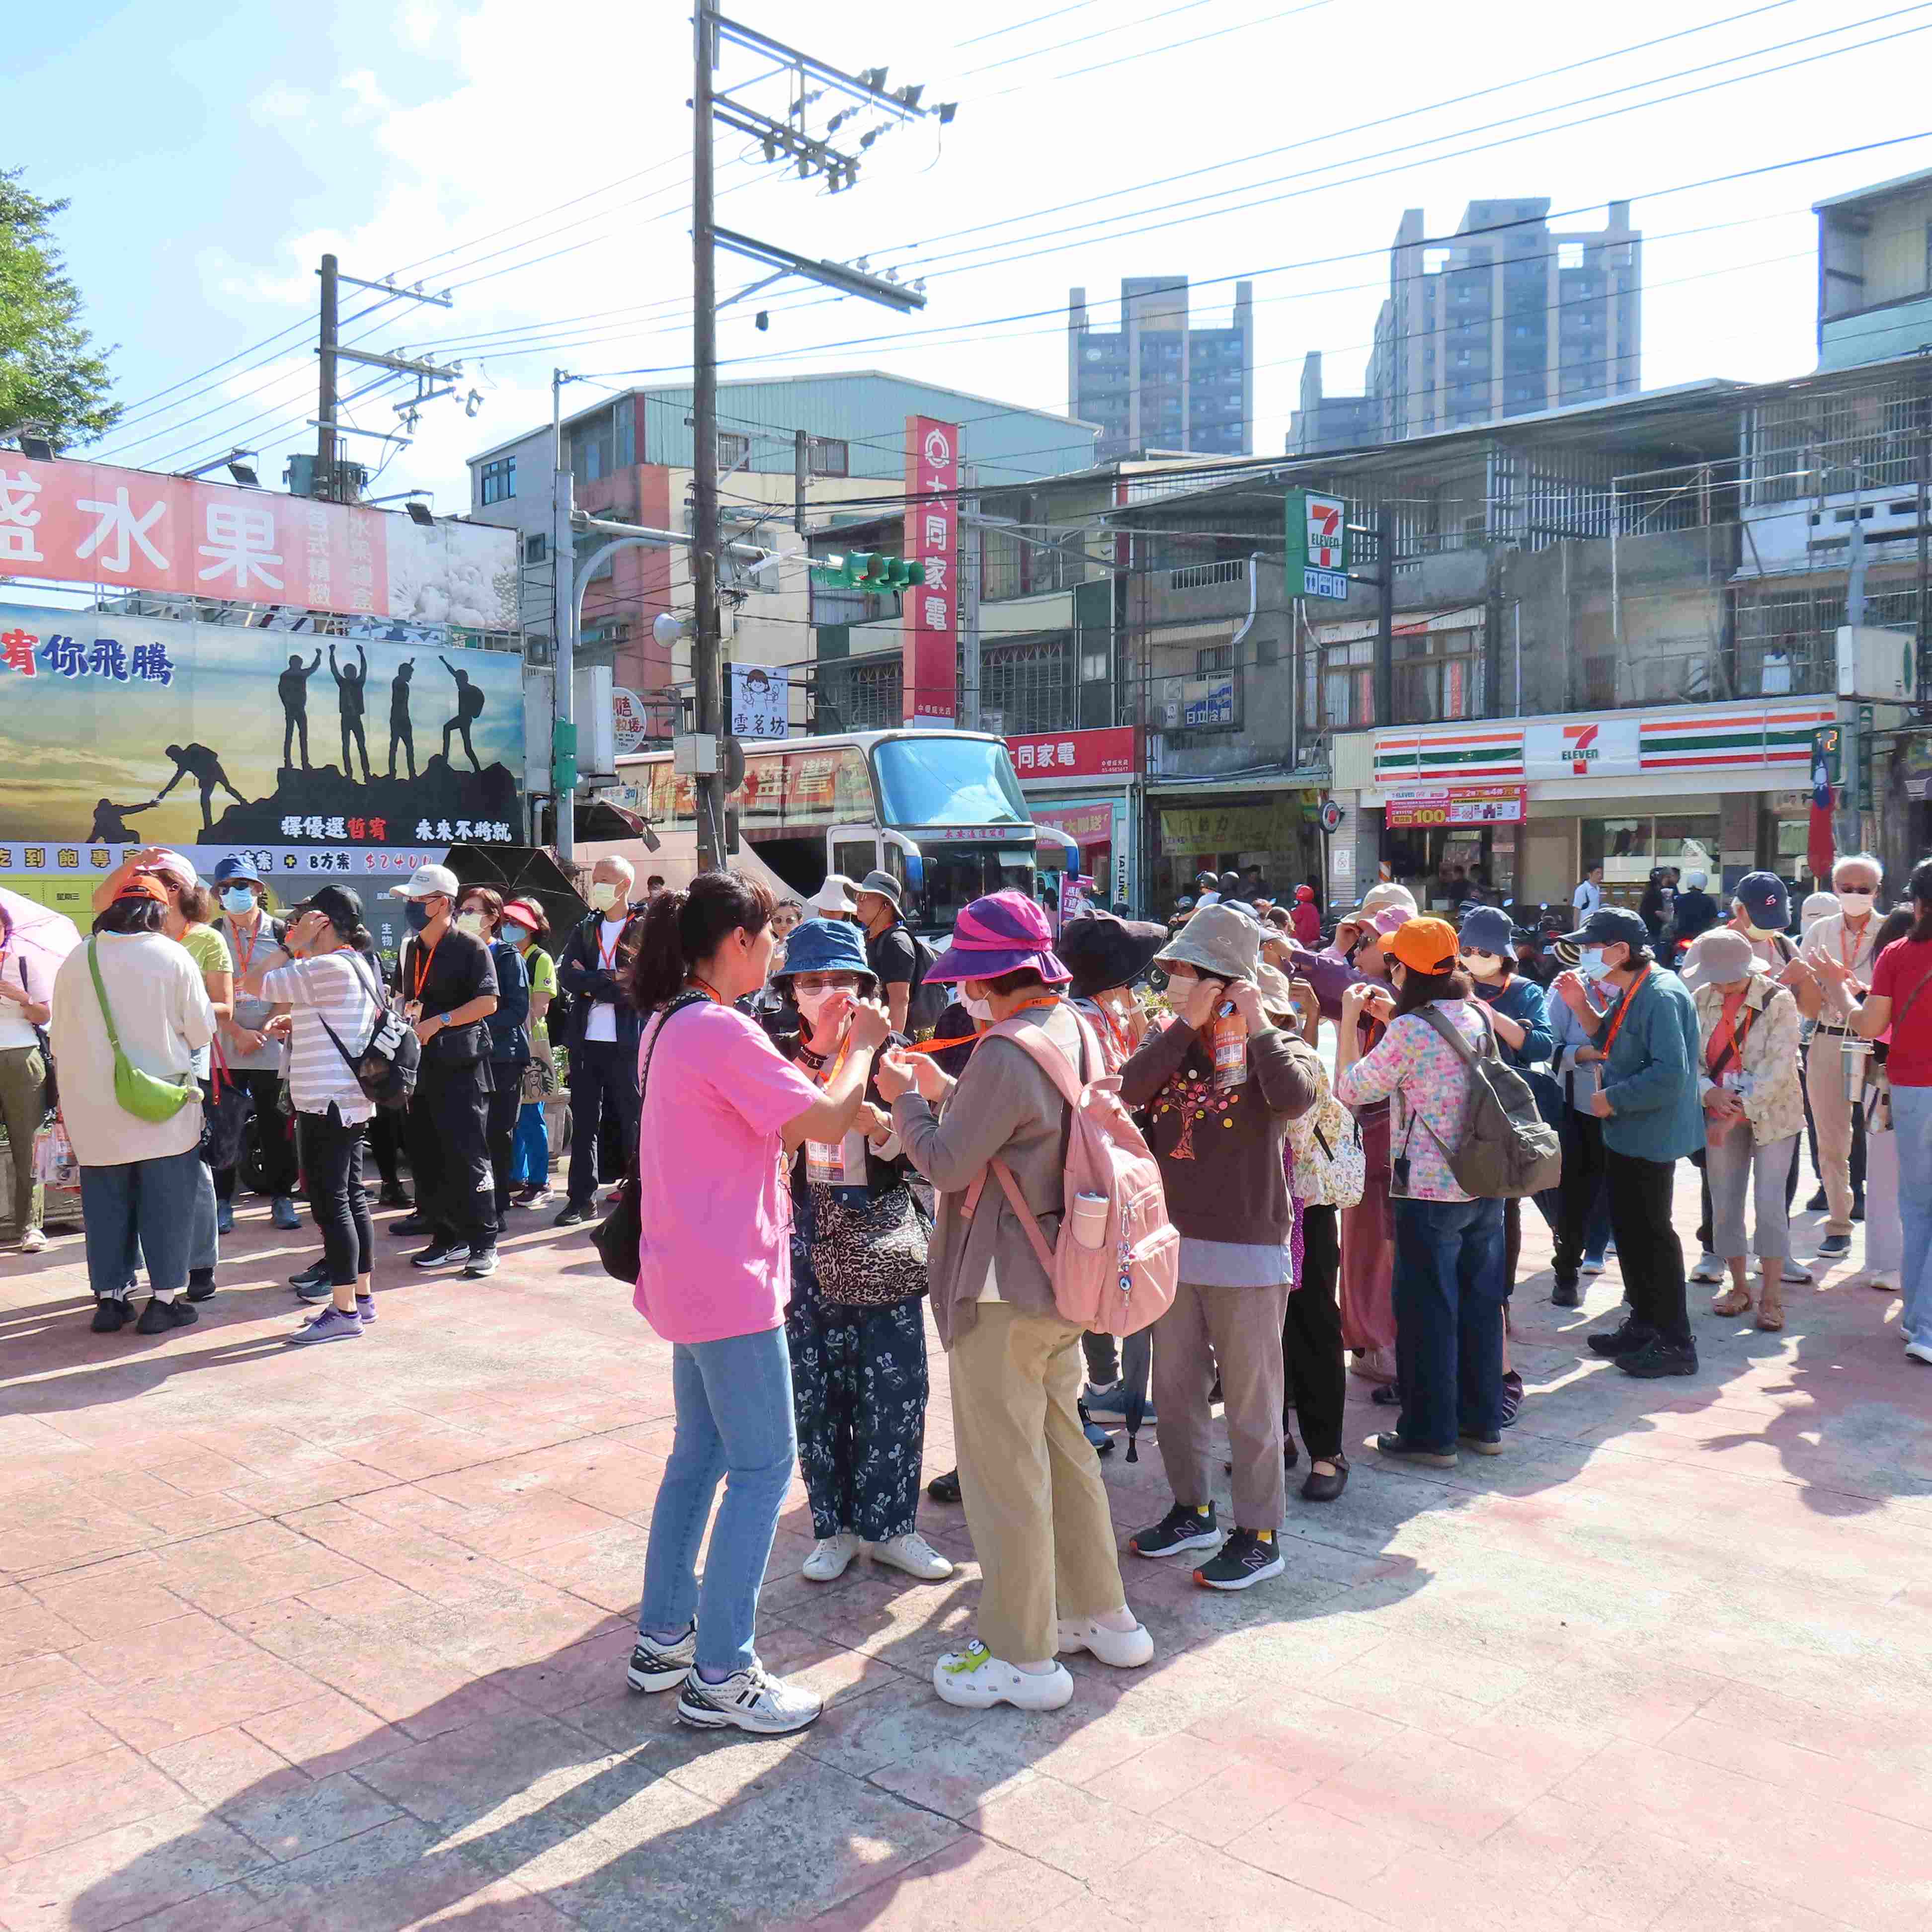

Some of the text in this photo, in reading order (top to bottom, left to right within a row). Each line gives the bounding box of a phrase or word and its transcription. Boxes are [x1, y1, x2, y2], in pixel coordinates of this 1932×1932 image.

[925, 475, 947, 631] 大同家電
[734, 713, 785, 735] 雪茗坊
[415, 818, 512, 842] 未來不將就
[309, 852, 351, 871] B方案
[381, 923, 393, 947] 生物
